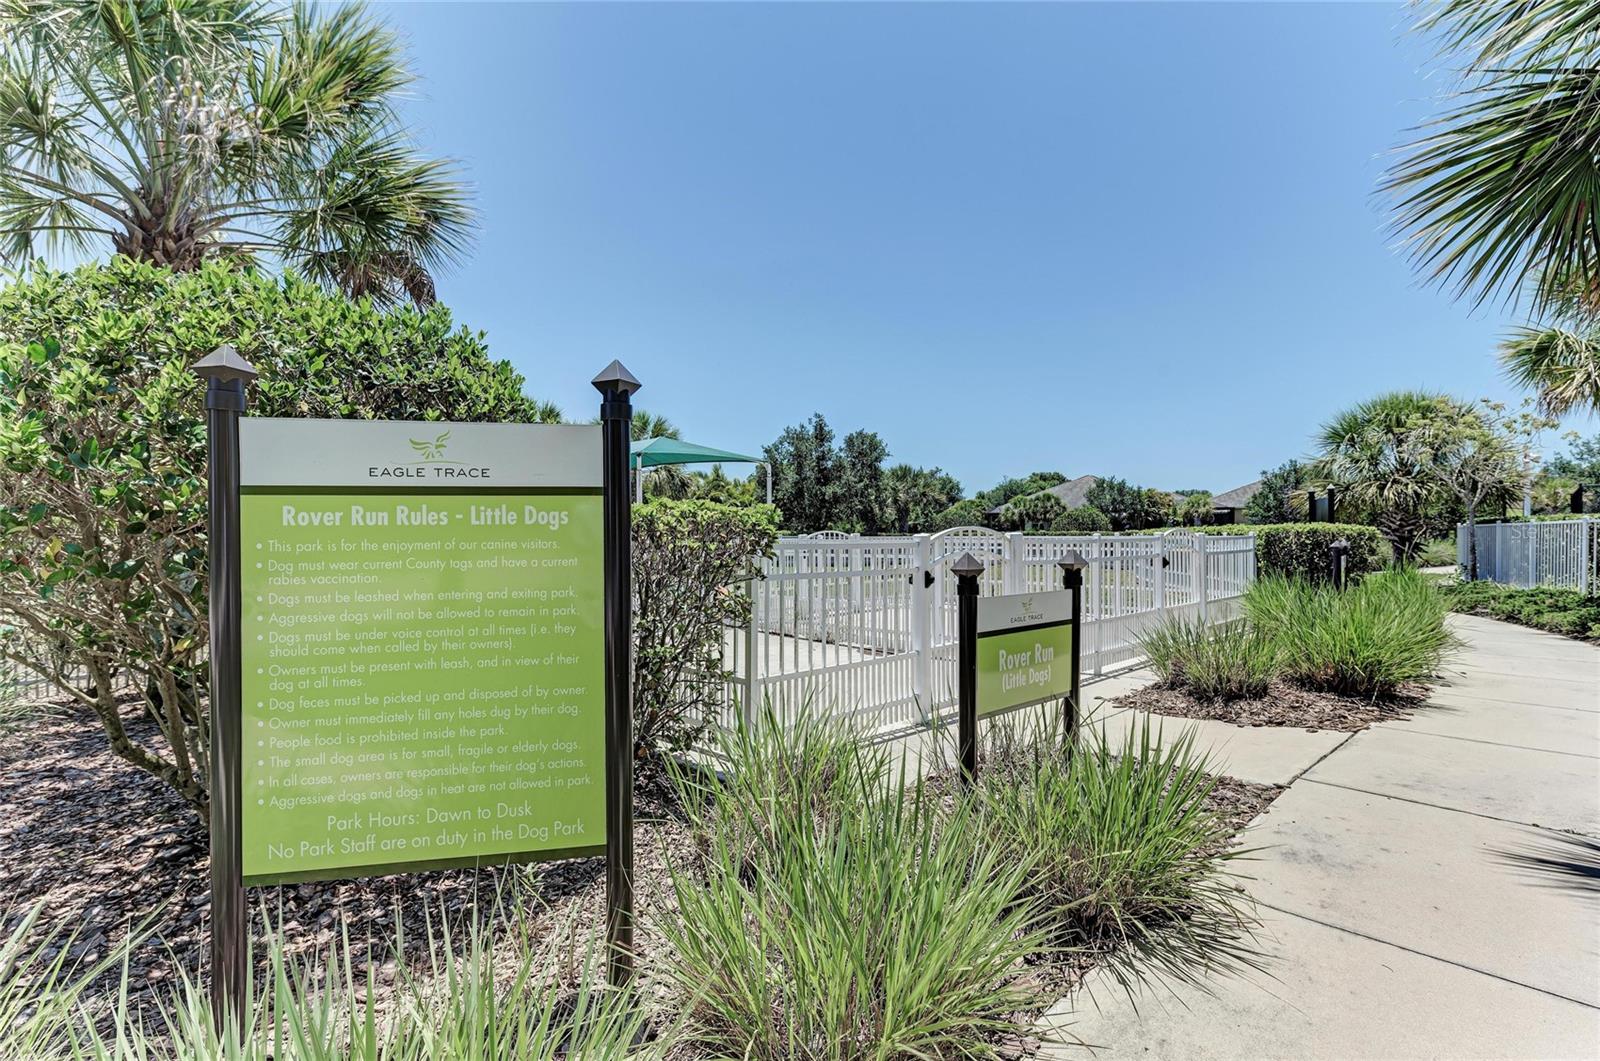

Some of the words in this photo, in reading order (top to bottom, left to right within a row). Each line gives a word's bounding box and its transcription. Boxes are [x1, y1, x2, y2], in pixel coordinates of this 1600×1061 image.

[369, 467, 425, 478] EAGLE
[434, 468, 490, 478] TRACE
[282, 506, 343, 526] Rover
[352, 506, 388, 525] Run
[396, 506, 448, 525] Rules
[470, 505, 517, 525] Little
[525, 506, 569, 529] Dogs
[269, 540, 291, 552] This
[296, 540, 323, 554] park
[328, 540, 336, 551] is
[341, 539, 356, 551] for
[361, 539, 378, 551] the
[382, 541, 441, 554] enjoyment
[445, 538, 455, 550] of
[459, 541, 477, 550] our
[481, 540, 517, 549] canine
[269, 560, 293, 573] Dog
[299, 560, 325, 570] must
[363, 559, 402, 569] current
[406, 558, 446, 571] County
[450, 559, 473, 571] tags
[477, 556, 497, 568] and
[502, 556, 527, 567] have
[531, 559, 538, 567] a
[542, 558, 578, 567] current
[269, 573, 306, 585] rabies
[269, 592, 300, 607] Dogs
[304, 593, 331, 604] must
[336, 592, 350, 603] be
[355, 591, 399, 602] leashed
[403, 590, 434, 600] when
[438, 590, 482, 602] entering
[487, 587, 508, 599] and
[512, 588, 547, 601] exiting
[269, 612, 335, 627] Aggressive
[340, 609, 368, 624] dogs
[372, 608, 392, 620] will
[397, 610, 414, 620] not
[418, 608, 432, 619] be
[436, 607, 480, 619] allowed
[484, 608, 495, 617] to
[500, 607, 535, 617] remain
[540, 606, 549, 616] in
[269, 631, 300, 646] Dogs
[305, 632, 331, 642] must
[336, 630, 350, 641] be
[355, 628, 387, 640] under
[392, 629, 422, 638] voice
[426, 625, 464, 637] control
[468, 626, 478, 636] at
[482, 624, 495, 636] all
[499, 625, 526, 635] times
[554, 622, 576, 636] they
[270, 644, 309, 657] should
[313, 646, 345, 655] come
[350, 641, 381, 653] when
[385, 641, 419, 652] called
[424, 639, 437, 653] by
[442, 640, 465, 650] their
[1000, 649, 1031, 672] Rover
[1035, 643, 1053, 664] Run
[269, 664, 316, 676] Owners
[321, 664, 346, 674] must
[351, 661, 365, 673] be
[369, 661, 410, 674] present
[414, 659, 436, 670] with
[477, 655, 498, 667] and
[502, 656, 511, 666] in
[515, 655, 539, 666] view
[543, 653, 553, 664] of
[557, 653, 580, 664] their
[269, 679, 293, 693] dog
[298, 679, 309, 689] at
[314, 676, 327, 688] all
[1003, 669, 1026, 693] (Little
[1029, 664, 1051, 686] Dogs)
[269, 717, 310, 729] Owner
[316, 716, 341, 726] must
[346, 711, 414, 725] immediately
[418, 708, 430, 721] fill
[434, 710, 455, 722] any
[459, 707, 487, 718] holes
[490, 706, 511, 719] dug
[515, 704, 528, 718] by
[531, 704, 553, 715] their
[270, 736, 311, 750] People
[315, 733, 341, 745] food
[347, 733, 355, 744] is
[360, 729, 418, 745] prohibited
[423, 726, 455, 740] inside
[460, 726, 476, 737] the
[270, 756, 290, 768] The
[296, 752, 325, 767] small
[330, 752, 353, 766] dog
[358, 752, 384, 762] area
[390, 749, 397, 760] is
[402, 748, 417, 759] for
[459, 744, 493, 758] fragile
[497, 744, 508, 753] or
[512, 741, 548, 753] elderly
[269, 775, 279, 788] In
[283, 774, 297, 786] all
[340, 771, 381, 783] owners
[384, 770, 403, 779] are
[407, 762, 469, 779] responsible
[472, 761, 486, 774] for
[490, 761, 512, 772] their
[269, 793, 335, 810] Aggressive
[338, 790, 366, 804] dogs
[370, 786, 392, 799] and
[396, 785, 423, 800] dogs
[428, 785, 437, 796] in
[441, 782, 464, 794] heat
[468, 783, 486, 793] are
[490, 782, 506, 791] not
[509, 776, 551, 790] allowed
[555, 777, 564, 786] in
[327, 812, 362, 831] Park
[369, 811, 420, 828] Hours:
[427, 807, 471, 824] Dawn
[477, 806, 491, 819] to
[497, 800, 533, 818] Dusk
[268, 843, 294, 860] No
[301, 838, 335, 856] Park
[341, 833, 376, 854] Staff
[381, 838, 406, 849] are
[411, 837, 430, 847] on
[436, 828, 468, 848] duty
[473, 829, 486, 842] in
[492, 824, 513, 840] the
[518, 823, 548, 841] Dog
[554, 818, 585, 836] Park
